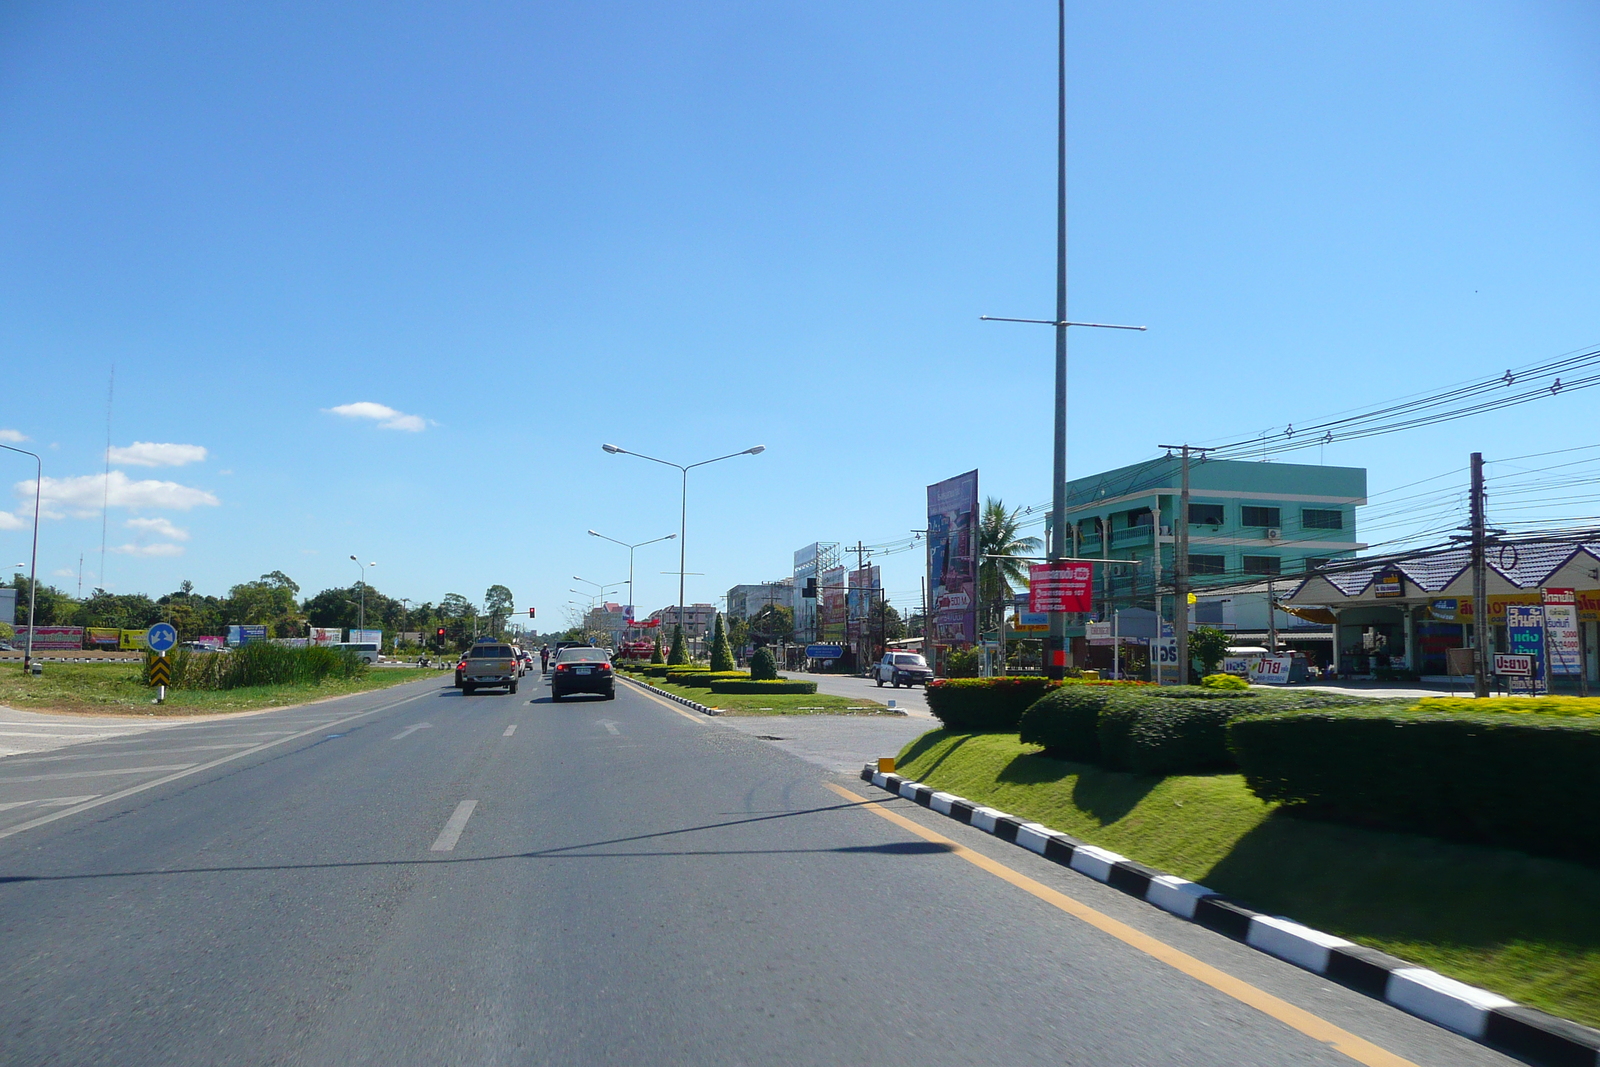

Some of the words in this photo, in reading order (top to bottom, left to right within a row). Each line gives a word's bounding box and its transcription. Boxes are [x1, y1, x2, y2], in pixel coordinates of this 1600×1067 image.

[1510, 608, 1542, 627] สินค้า
[1514, 630, 1539, 642] แต่ง
[1226, 659, 1247, 671] แอร์
[1496, 656, 1528, 669] ปะยาง
